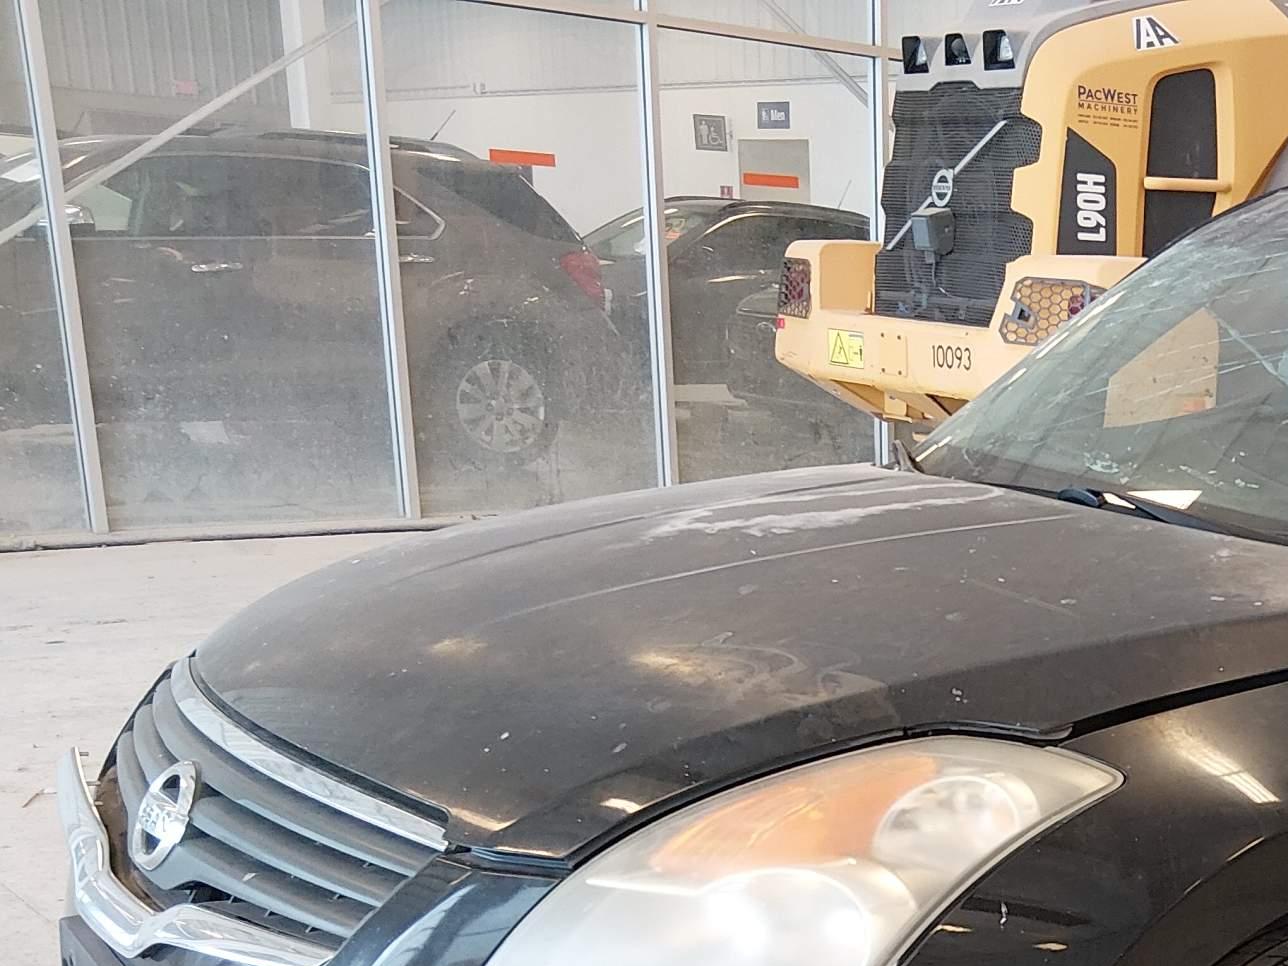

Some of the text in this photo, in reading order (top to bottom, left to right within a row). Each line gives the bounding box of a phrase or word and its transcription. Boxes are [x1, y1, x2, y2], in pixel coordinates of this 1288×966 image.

[770, 109, 786, 121] Men
[1077, 102, 1138, 115] MACHINERY
[1076, 172, 1107, 242] L90H
[931, 344, 972, 371] 10093
